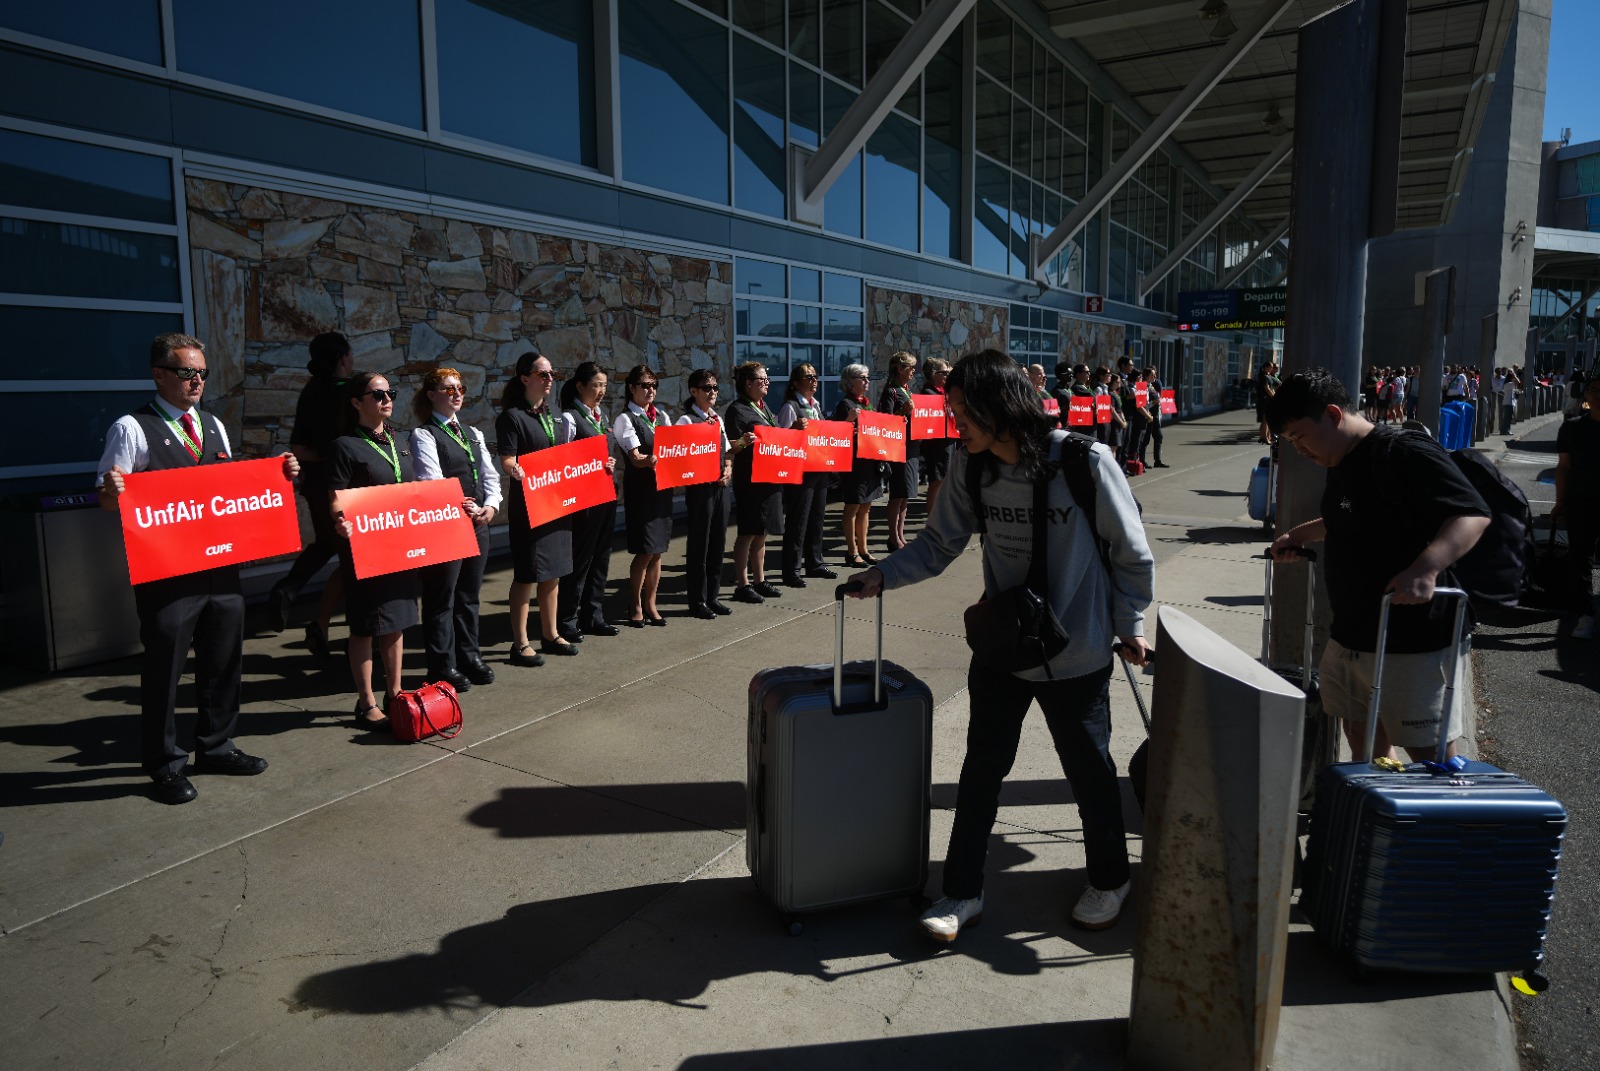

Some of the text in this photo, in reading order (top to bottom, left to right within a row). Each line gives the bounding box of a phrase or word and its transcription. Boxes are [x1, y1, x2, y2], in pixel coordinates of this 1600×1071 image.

[1190, 307, 1229, 317] 150-199
[1214, 320, 1243, 329] Canada
[862, 424, 903, 440] UnfAir Canada
[807, 435, 851, 448] UnfAir Canada
[659, 441, 717, 459] UnfAir Canada
[759, 443, 804, 459] UnfAir Canada
[527, 458, 603, 491] UnfAir Canada
[135, 489, 284, 528] UnfAir Canada
[562, 497, 577, 507] CUPE
[356, 504, 461, 533] UnfAir Canada
[205, 543, 233, 556] CUPE
[406, 547, 426, 558] CUPE
